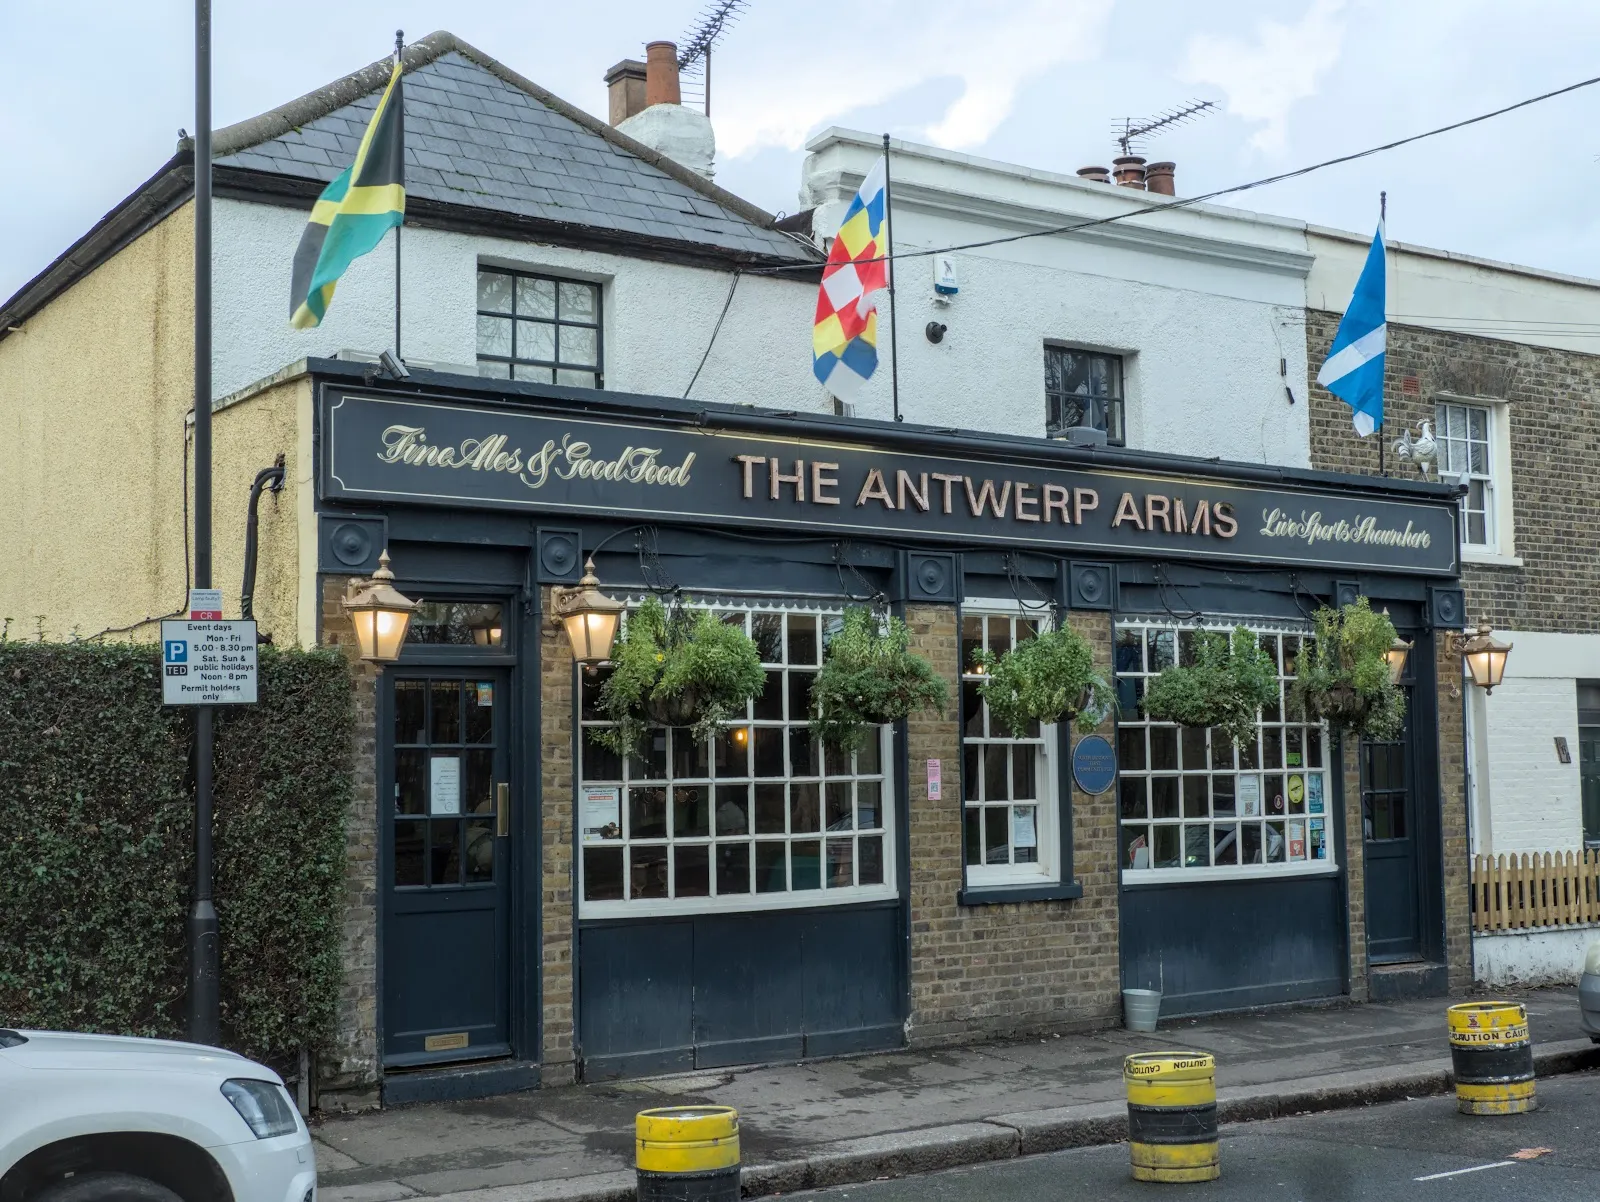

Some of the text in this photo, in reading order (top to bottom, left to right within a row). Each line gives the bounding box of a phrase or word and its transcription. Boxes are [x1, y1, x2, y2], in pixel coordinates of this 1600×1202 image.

[376, 424, 697, 489] Fine Ales & Good Food
[735, 454, 1239, 539] THE ANTWERP ARMS
[1259, 507, 1298, 538] Live
[1297, 509, 1350, 546] Sports
[200, 611, 213, 620] CR
[187, 623, 232, 633] Event days
[206, 634, 224, 642] Mon
[230, 634, 241, 642] Fri
[170, 642, 184, 661] P
[193, 644, 214, 652] 5.00
[220, 644, 240, 652] 8.30
[241, 645, 254, 653] pm
[167, 666, 187, 675] TED
[193, 663, 254, 672] public holidays
[200, 673, 222, 681] Noon
[235, 674, 248, 682] pm
[210, 684, 240, 692] holders
[202, 693, 220, 701] only
[1173, 1059, 1207, 1069] CAUTION
